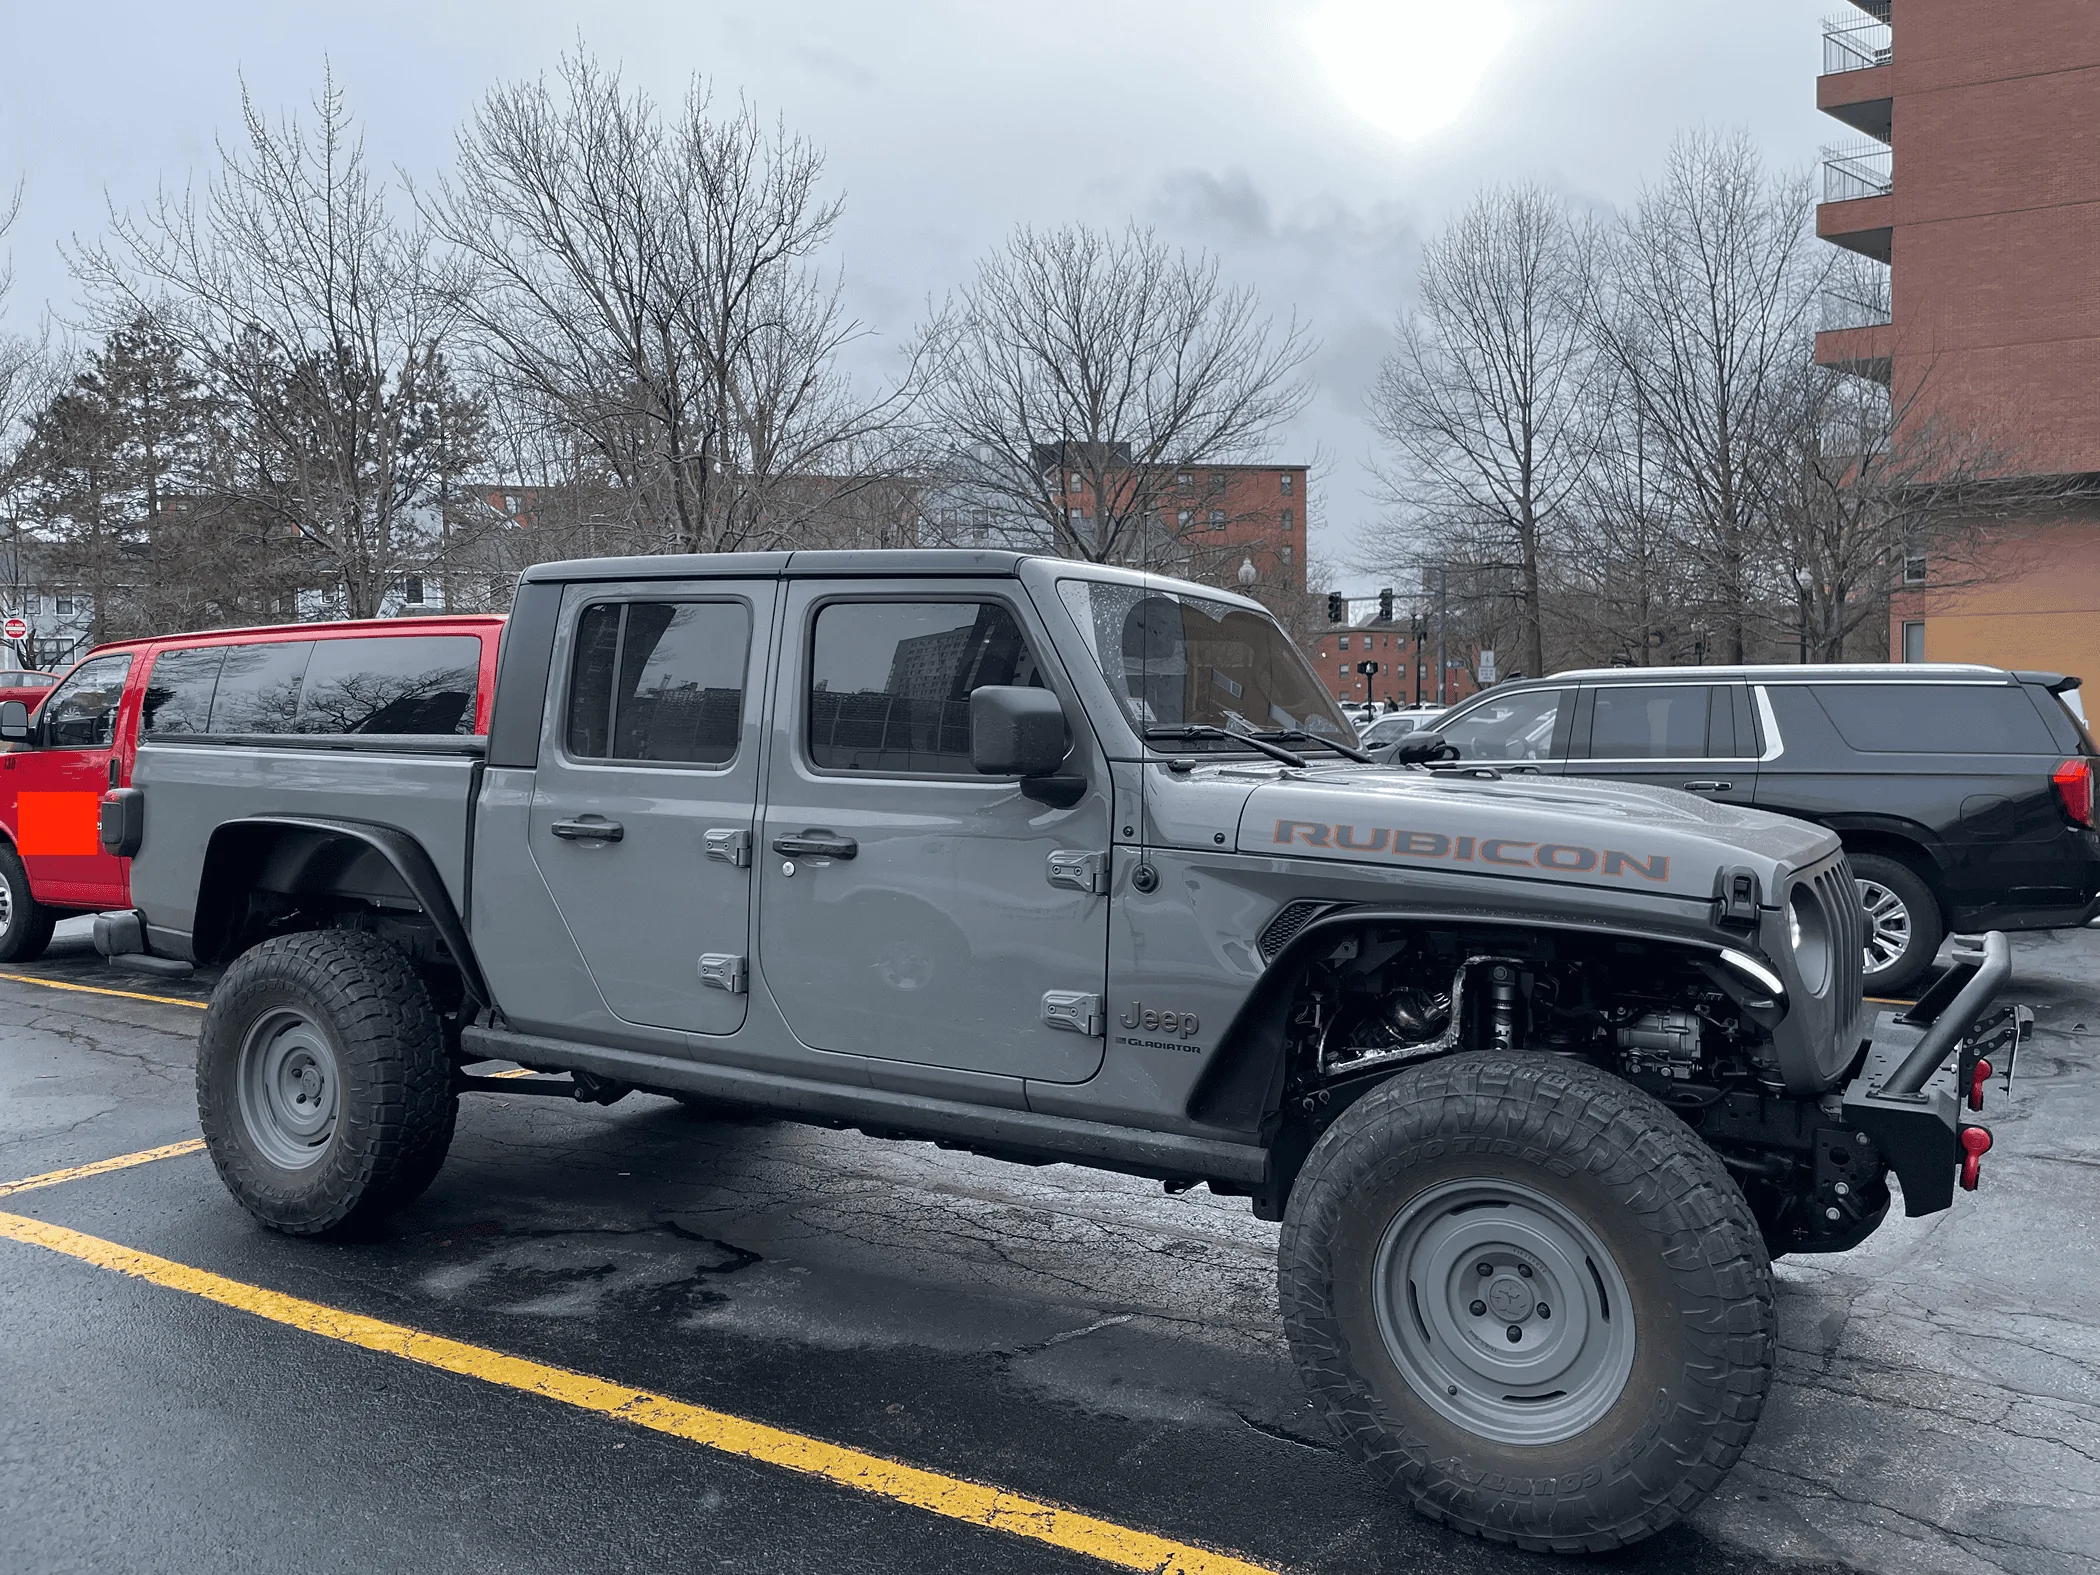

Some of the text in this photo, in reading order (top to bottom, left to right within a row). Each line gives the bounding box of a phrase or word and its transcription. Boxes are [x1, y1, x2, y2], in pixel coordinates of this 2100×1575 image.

[1273, 819, 1671, 882] RUBICON
[1120, 1001, 1199, 1040] Jeep
[1128, 1038, 1202, 1055] GLADIATOR
[1453, 1136, 1577, 1178] TIRES
